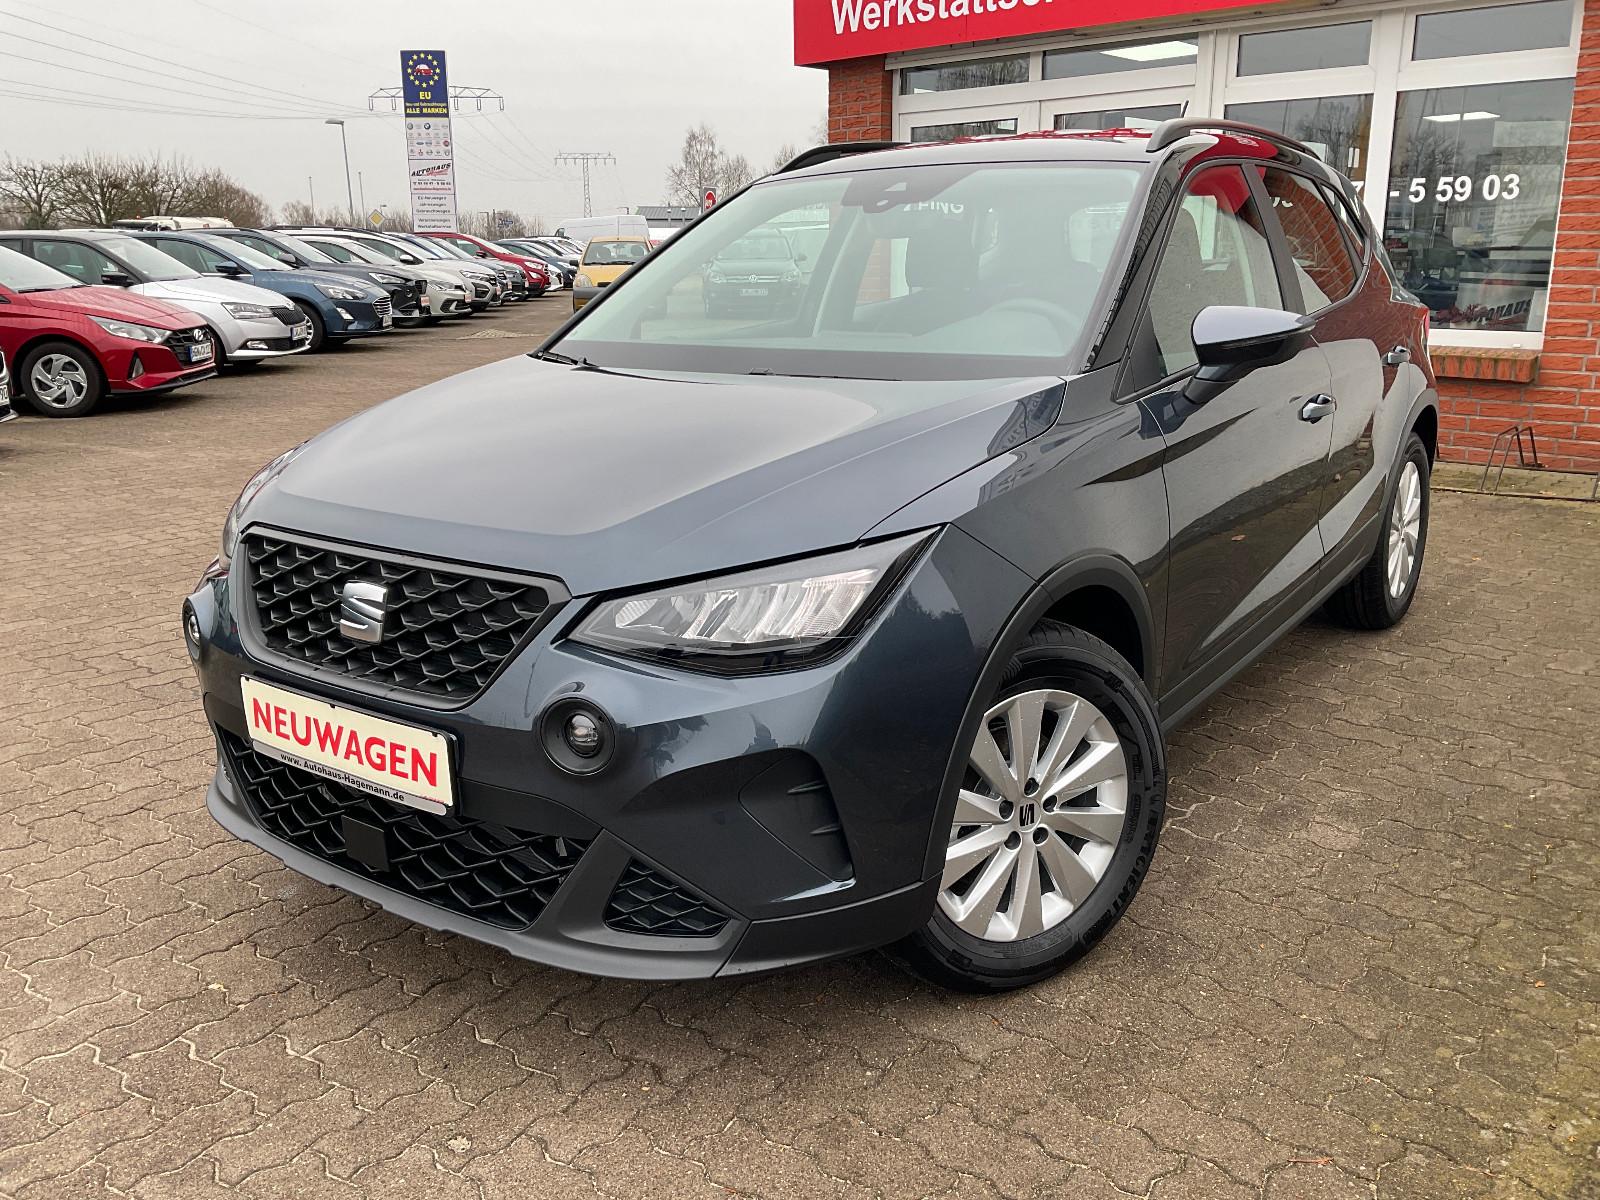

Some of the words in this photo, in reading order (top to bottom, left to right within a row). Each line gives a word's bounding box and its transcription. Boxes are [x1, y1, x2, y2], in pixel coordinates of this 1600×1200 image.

[419, 91, 432, 100] EU
[411, 162, 452, 177] AUTOHAUS
[1408, 177, 1426, 203] 5
[1435, 175, 1472, 202] 59
[1482, 173, 1520, 201] 03
[252, 697, 437, 787] NEUWAGEN
[280, 753, 302, 767] www.
[303, 761, 405, 801] Autohaus-Hagemann.de
